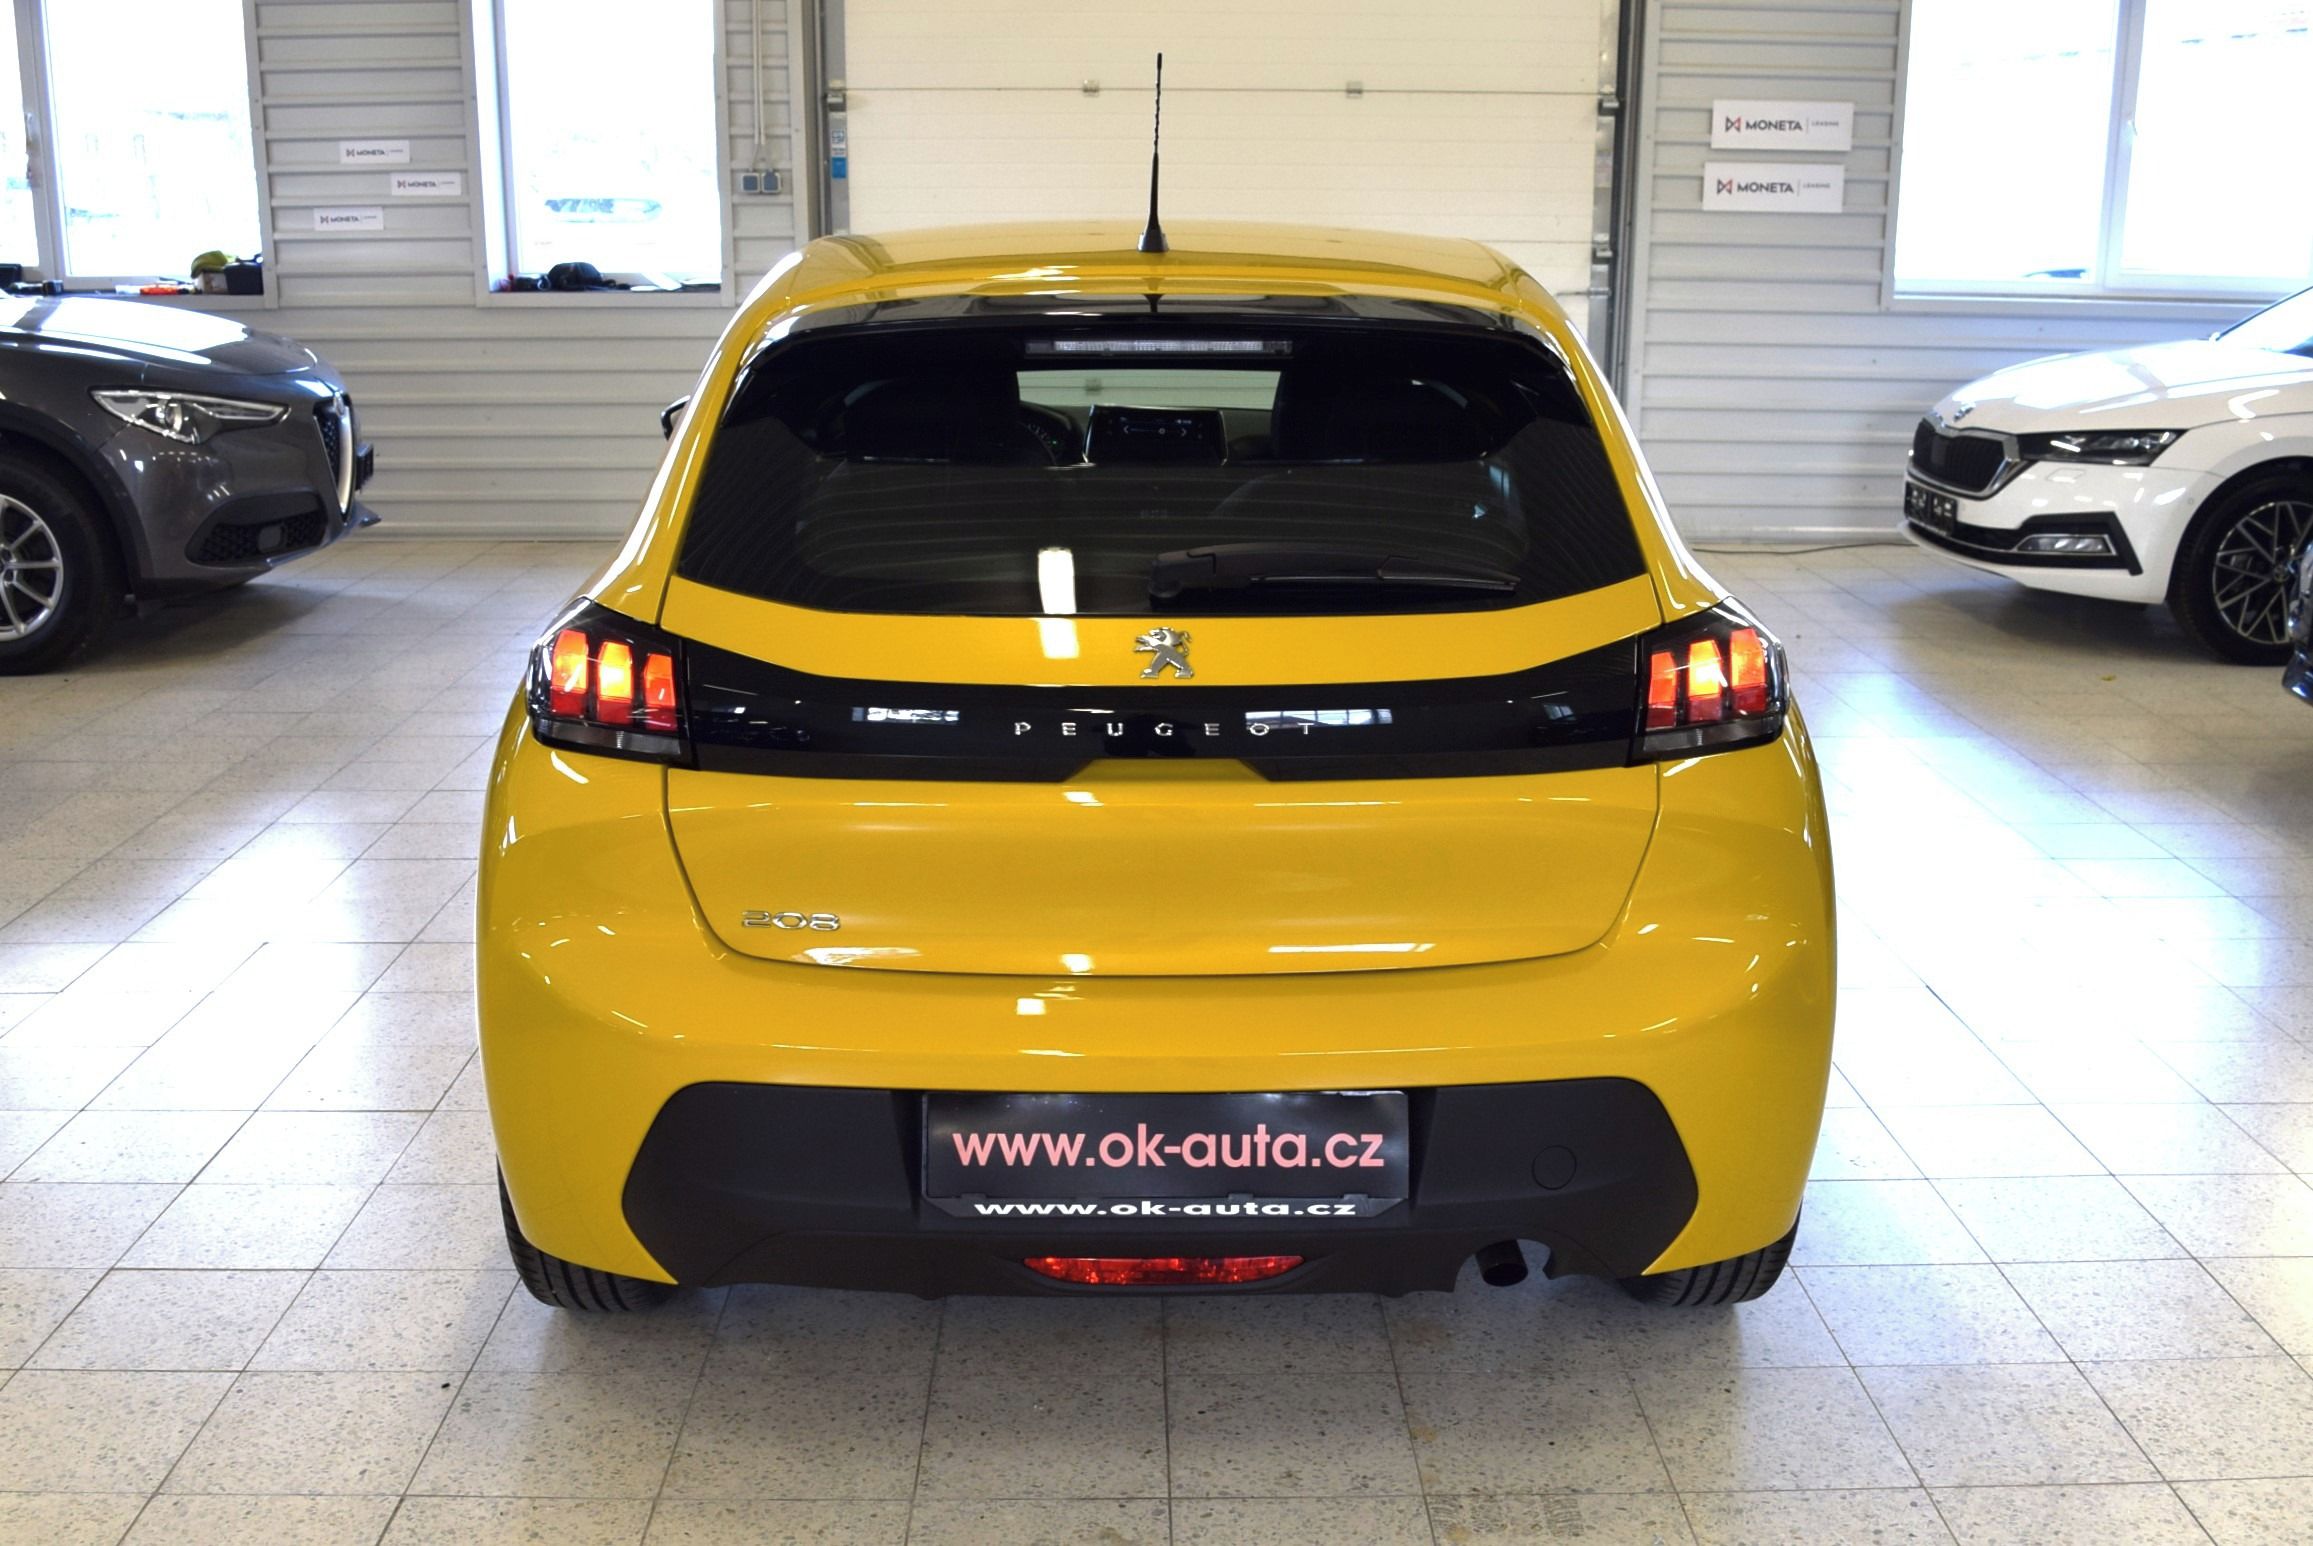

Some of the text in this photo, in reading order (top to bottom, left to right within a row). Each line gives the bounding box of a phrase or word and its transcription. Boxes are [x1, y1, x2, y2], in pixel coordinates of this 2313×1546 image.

[1745, 119, 1803, 131] MONETA
[1736, 182, 1794, 193] MONETA
[1014, 722, 1315, 737] PEUGEOT
[742, 911, 841, 931] 208
[952, 1123, 1385, 1168] www.ok-auta.cz
[974, 1200, 1357, 1216] www.ok-auta.cz
